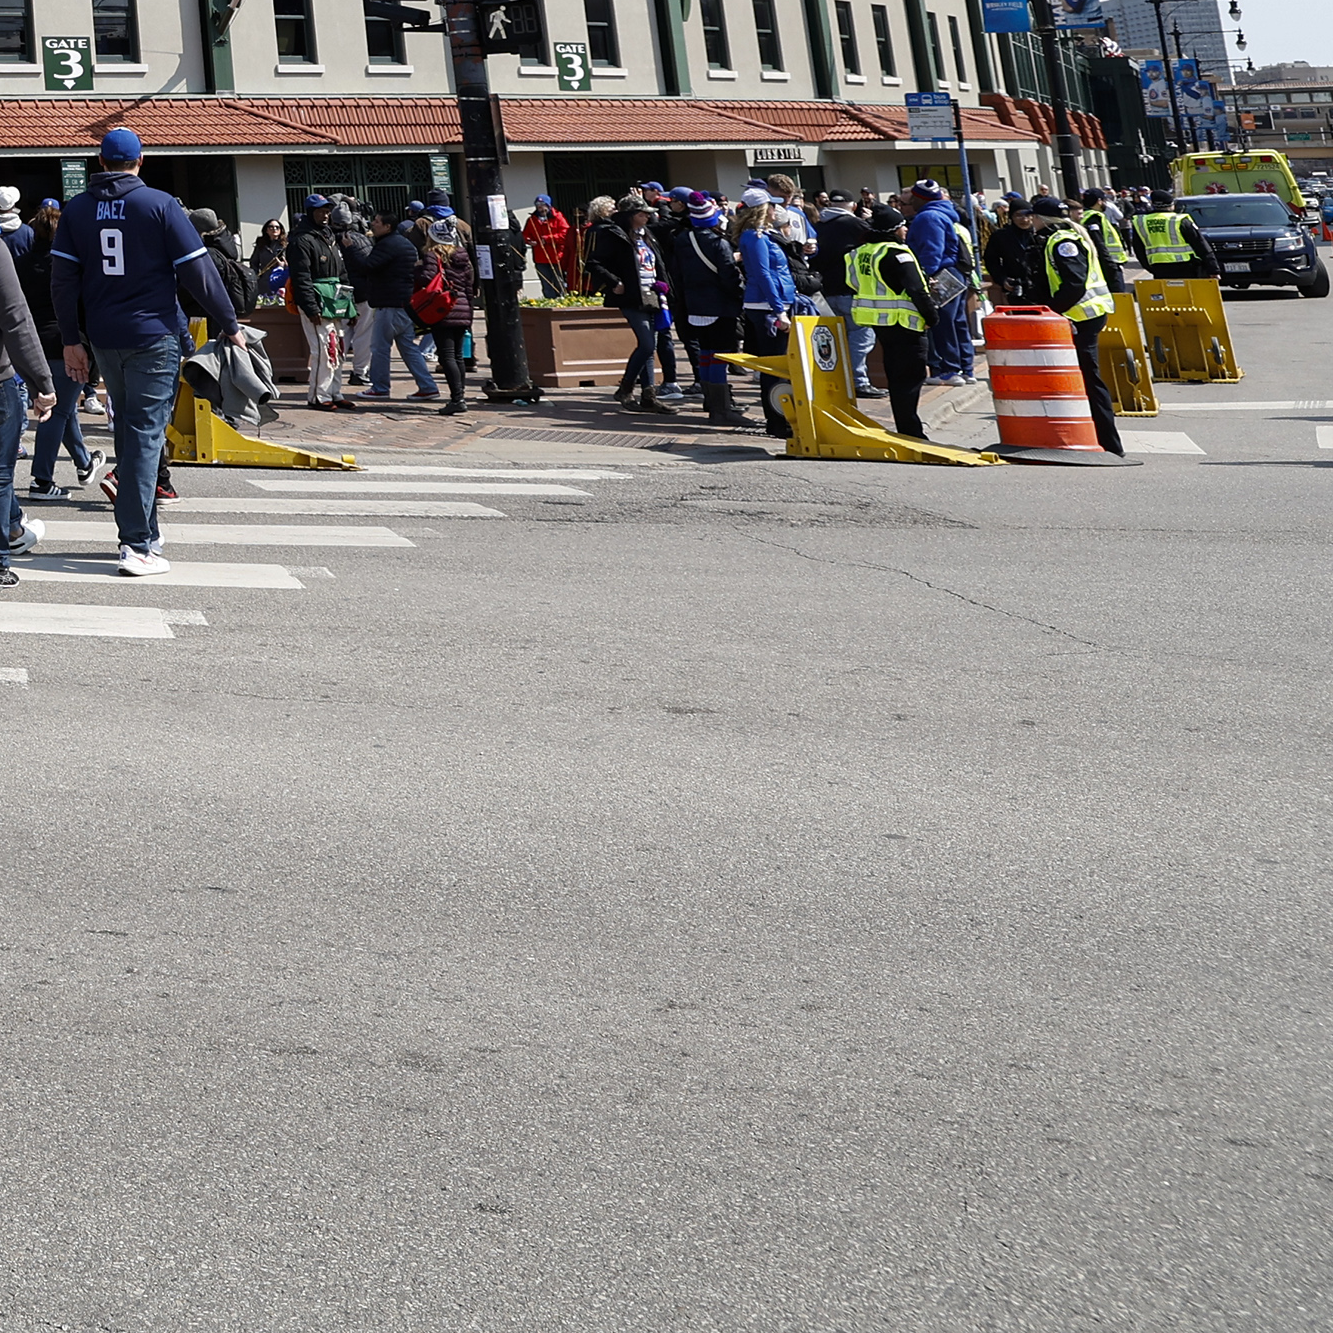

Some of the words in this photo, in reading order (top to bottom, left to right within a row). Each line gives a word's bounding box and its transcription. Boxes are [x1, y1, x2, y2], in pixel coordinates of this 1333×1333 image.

[45, 38, 88, 49] GATE
[555, 43, 586, 54] GATE
[53, 49, 84, 79] 3
[561, 53, 585, 81] 3
[96, 199, 126, 221] BAEZ
[100, 228, 125, 276] 9
